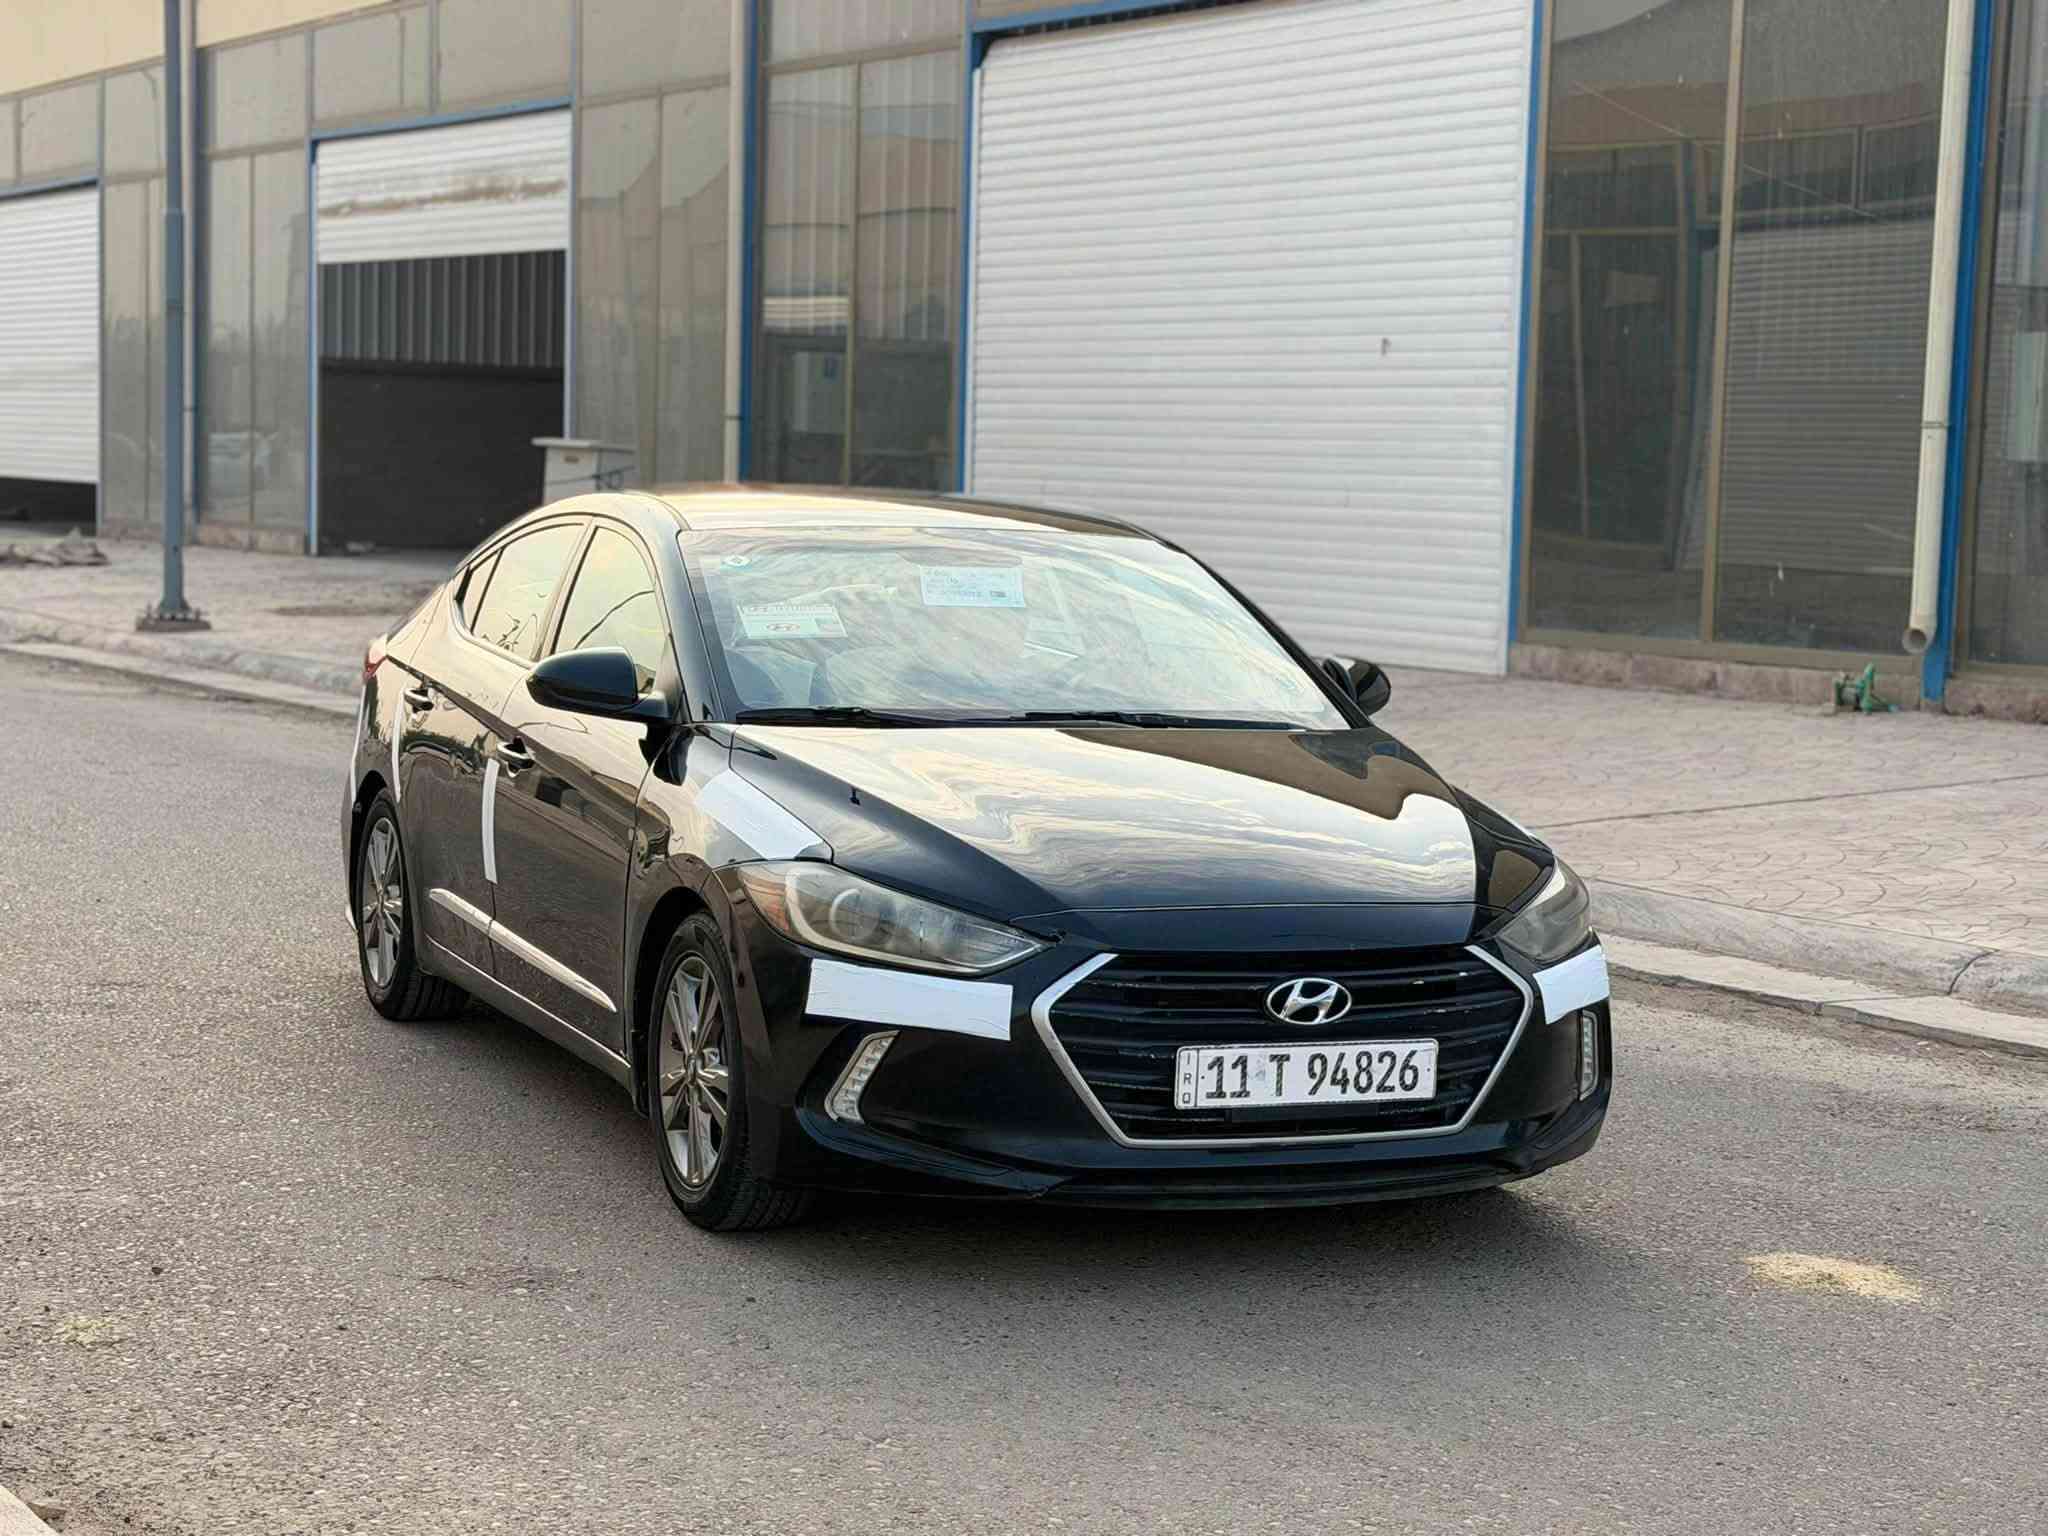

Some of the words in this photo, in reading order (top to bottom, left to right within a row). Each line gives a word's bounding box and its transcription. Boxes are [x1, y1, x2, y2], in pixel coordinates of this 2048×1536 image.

[1206, 1055, 1251, 1099] 11
[1268, 1053, 1291, 1097] T
[1307, 1049, 1419, 1096] 94826
